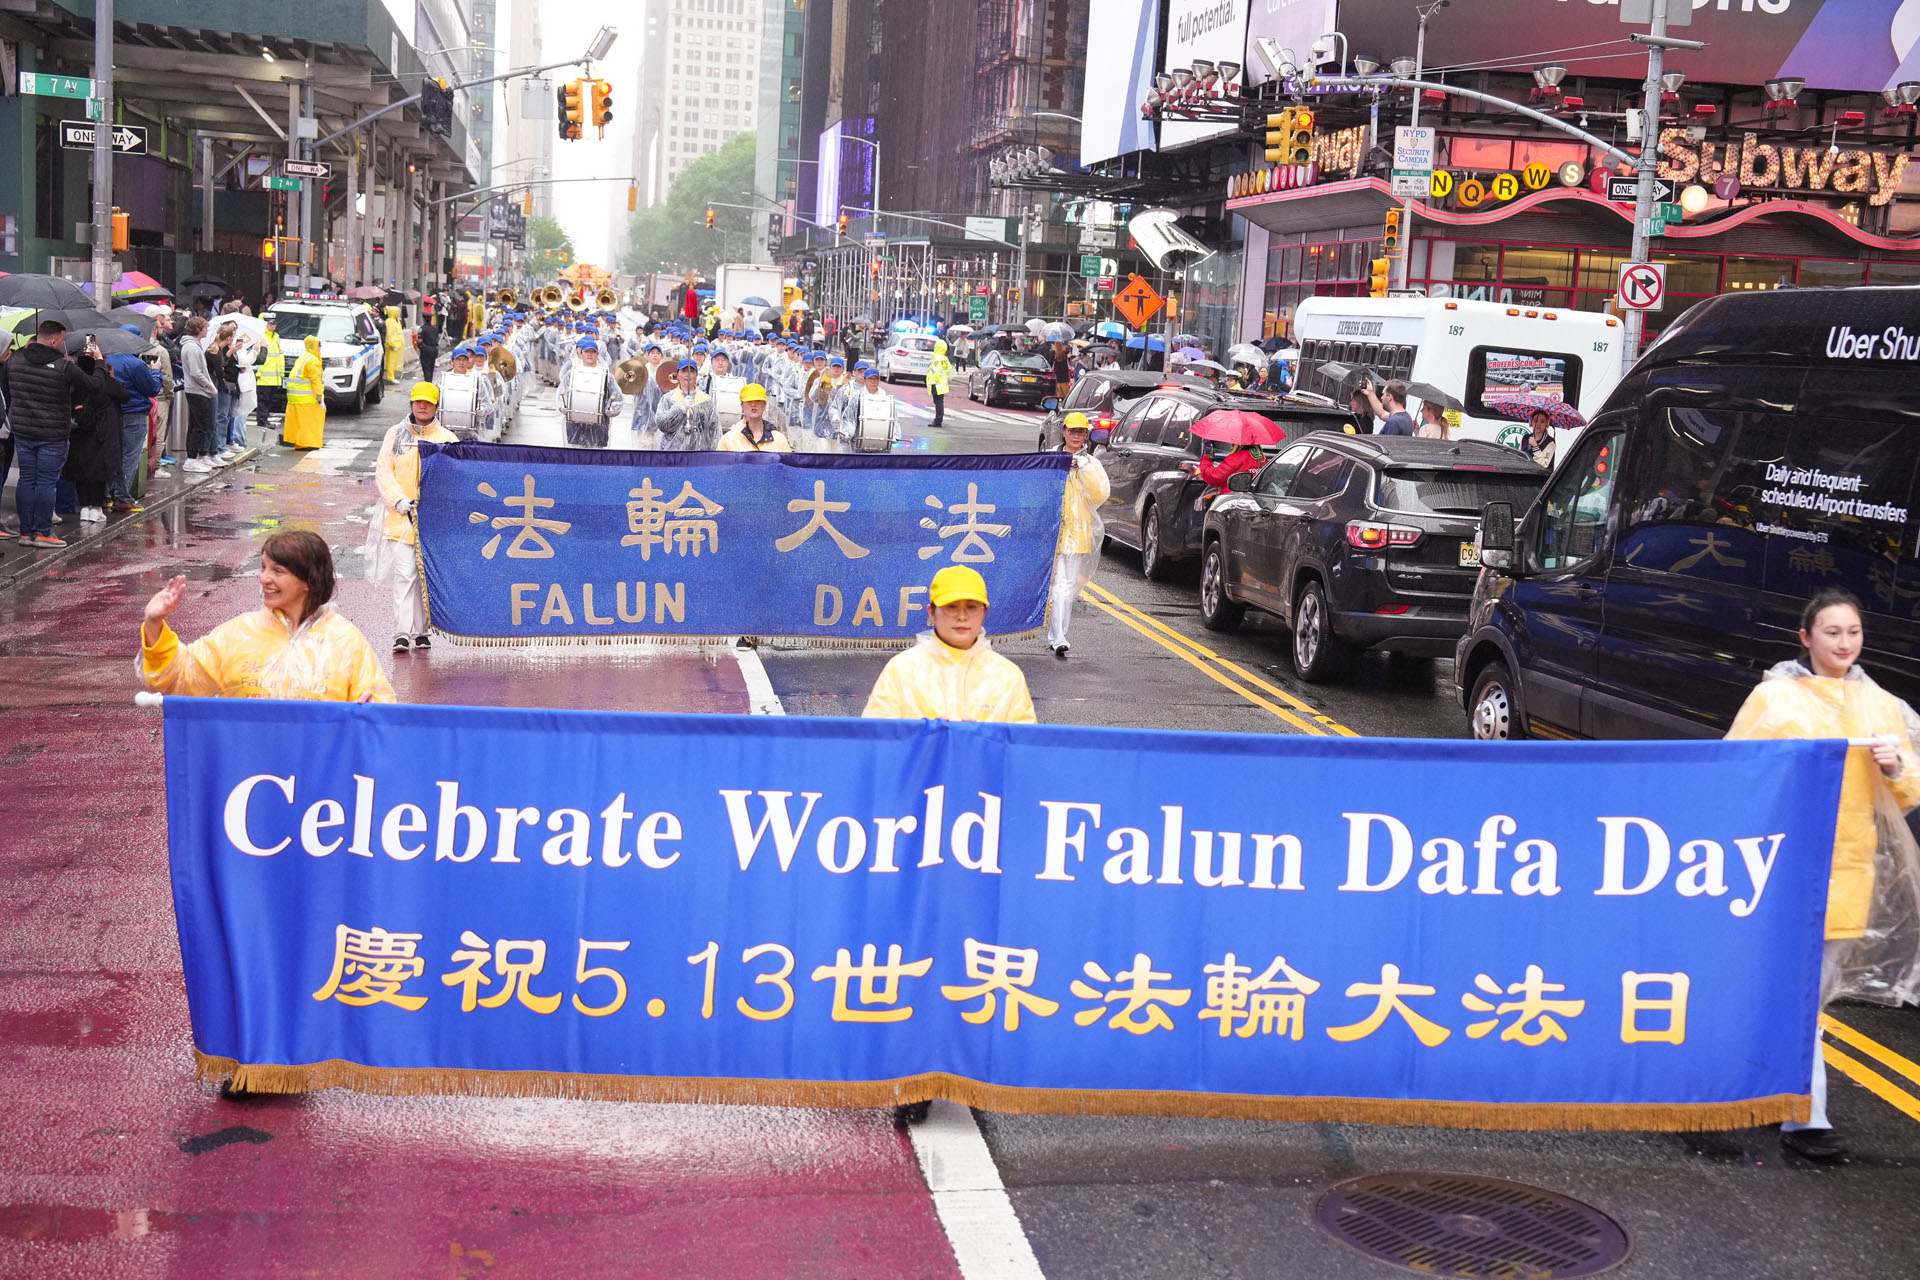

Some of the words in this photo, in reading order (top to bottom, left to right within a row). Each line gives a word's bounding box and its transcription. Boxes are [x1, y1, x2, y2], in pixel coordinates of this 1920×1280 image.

[1177, 11, 1192, 45] full
[1191, 0, 1236, 47] potential.
[50, 78, 58, 93] 7
[64, 79, 78, 90] Av
[73, 130, 95, 142] ONE
[1403, 129, 1427, 138] NYPD
[290, 164, 305, 172] ONE
[310, 164, 324, 174] WAY
[1656, 127, 1910, 207] Subway
[278, 179, 283, 188] 7
[1433, 175, 1447, 193] N
[1464, 183, 1480, 202] Q
[1498, 178, 1513, 196] R
[1528, 168, 1548, 186] W
[1564, 164, 1579, 183] S
[1600, 171, 1608, 189] 1
[1723, 178, 1734, 196] 7
[1614, 185, 1633, 195] ONE
[1653, 186, 1663, 195] AY
[1336, 320, 1361, 336] EXPRESS
[1359, 321, 1384, 337] SERVICE
[1448, 325, 1465, 336] 187
[1593, 341, 1608, 352] 187
[1825, 326, 1880, 359] Uber
[1488, 360, 1519, 369] CHOFERES
[1765, 463, 1791, 487] Daily
[1790, 468, 1814, 486] and
[1812, 469, 1862, 494] frequent
[1760, 487, 1815, 510] scheduled
[1814, 493, 1855, 516] Airport
[1856, 499, 1908, 523] transfers
[468, 474, 1012, 563] 法輪大法
[1756, 522, 1769, 533] Uber
[511, 581, 686, 626] FALUN
[813, 583, 935, 628] DAF
[223, 773, 684, 870] Celebrate
[718, 784, 1003, 876] World
[1034, 799, 1306, 892] Falun
[1338, 811, 1562, 897] Dafa
[1593, 815, 1787, 918] Day
